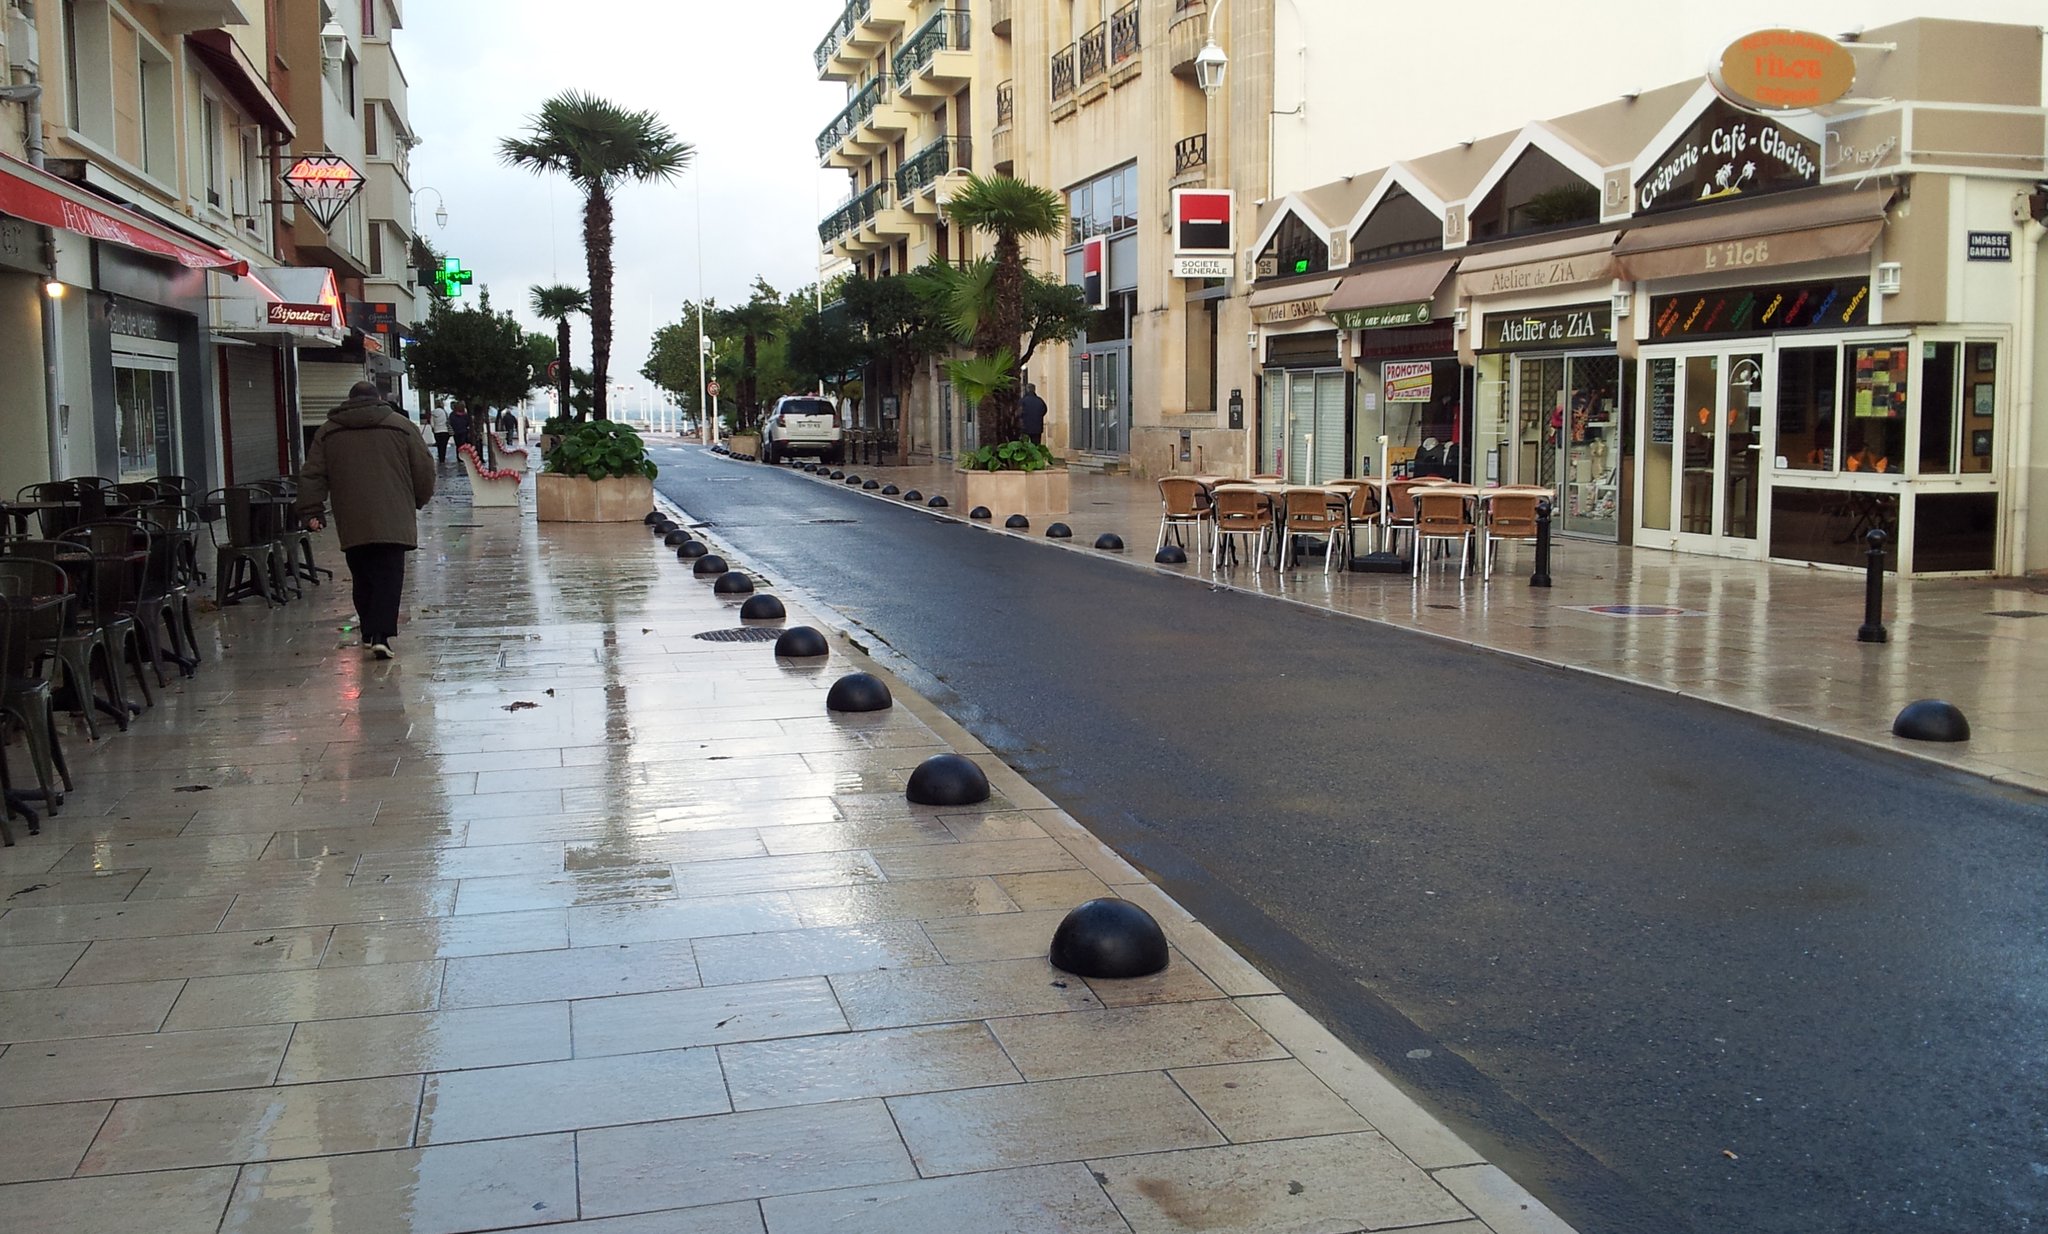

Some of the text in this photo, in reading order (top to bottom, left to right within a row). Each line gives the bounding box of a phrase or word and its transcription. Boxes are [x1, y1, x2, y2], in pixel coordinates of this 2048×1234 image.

[1640, 143, 1699, 209] Crêperie
[1711, 124, 1746, 159] Café
[1760, 127, 1816, 180] Glacier
[1969, 246, 2010, 257] GAMBETTA
[1971, 235, 2008, 246] IMPASSE
[1181, 260, 1220, 268] SOCIETE
[1181, 267, 1228, 275] GENERALE
[1491, 265, 1532, 291] Atelier
[1534, 269, 1546, 284] de
[269, 304, 331, 323] Bijouterie
[1683, 298, 1705, 331] SALADES
[1761, 294, 1782, 324] PIZZAS
[1842, 286, 1868, 323] gaufres
[1500, 312, 1595, 343] Atelier de ZiA
[1386, 363, 1430, 379] PROMOTION
